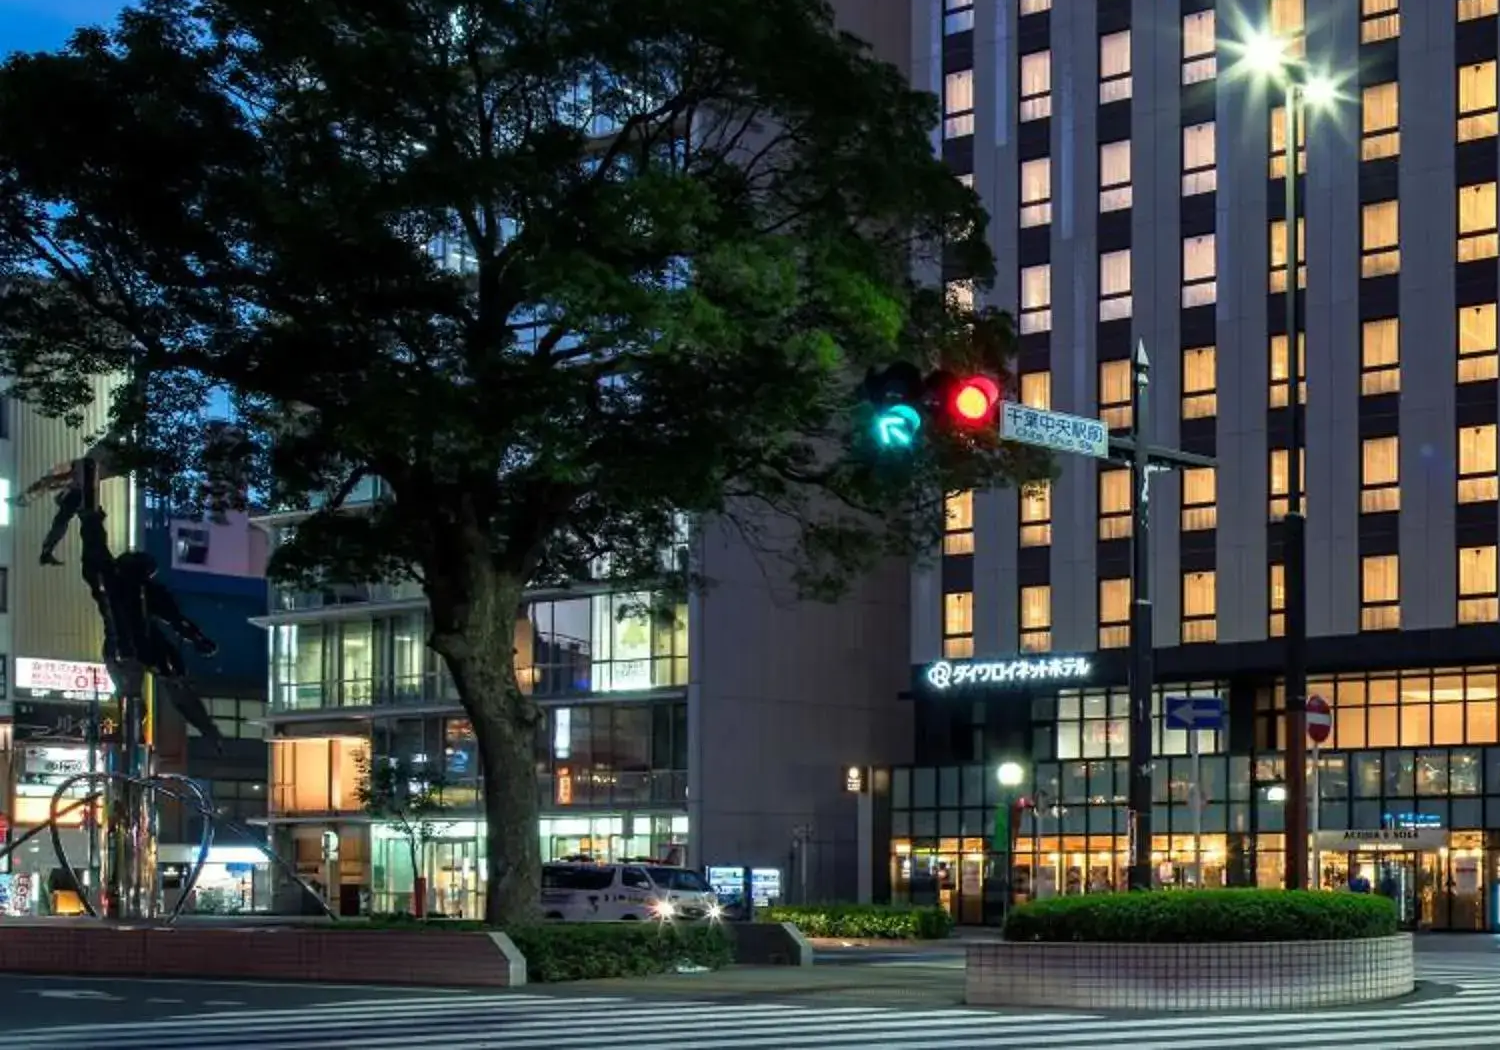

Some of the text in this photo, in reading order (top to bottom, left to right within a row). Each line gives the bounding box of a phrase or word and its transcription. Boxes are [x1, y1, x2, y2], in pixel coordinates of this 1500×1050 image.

[1007, 407, 1104, 443] 千葉中央駅前
[953, 657, 1090, 685] ダイワロイネットホテル
